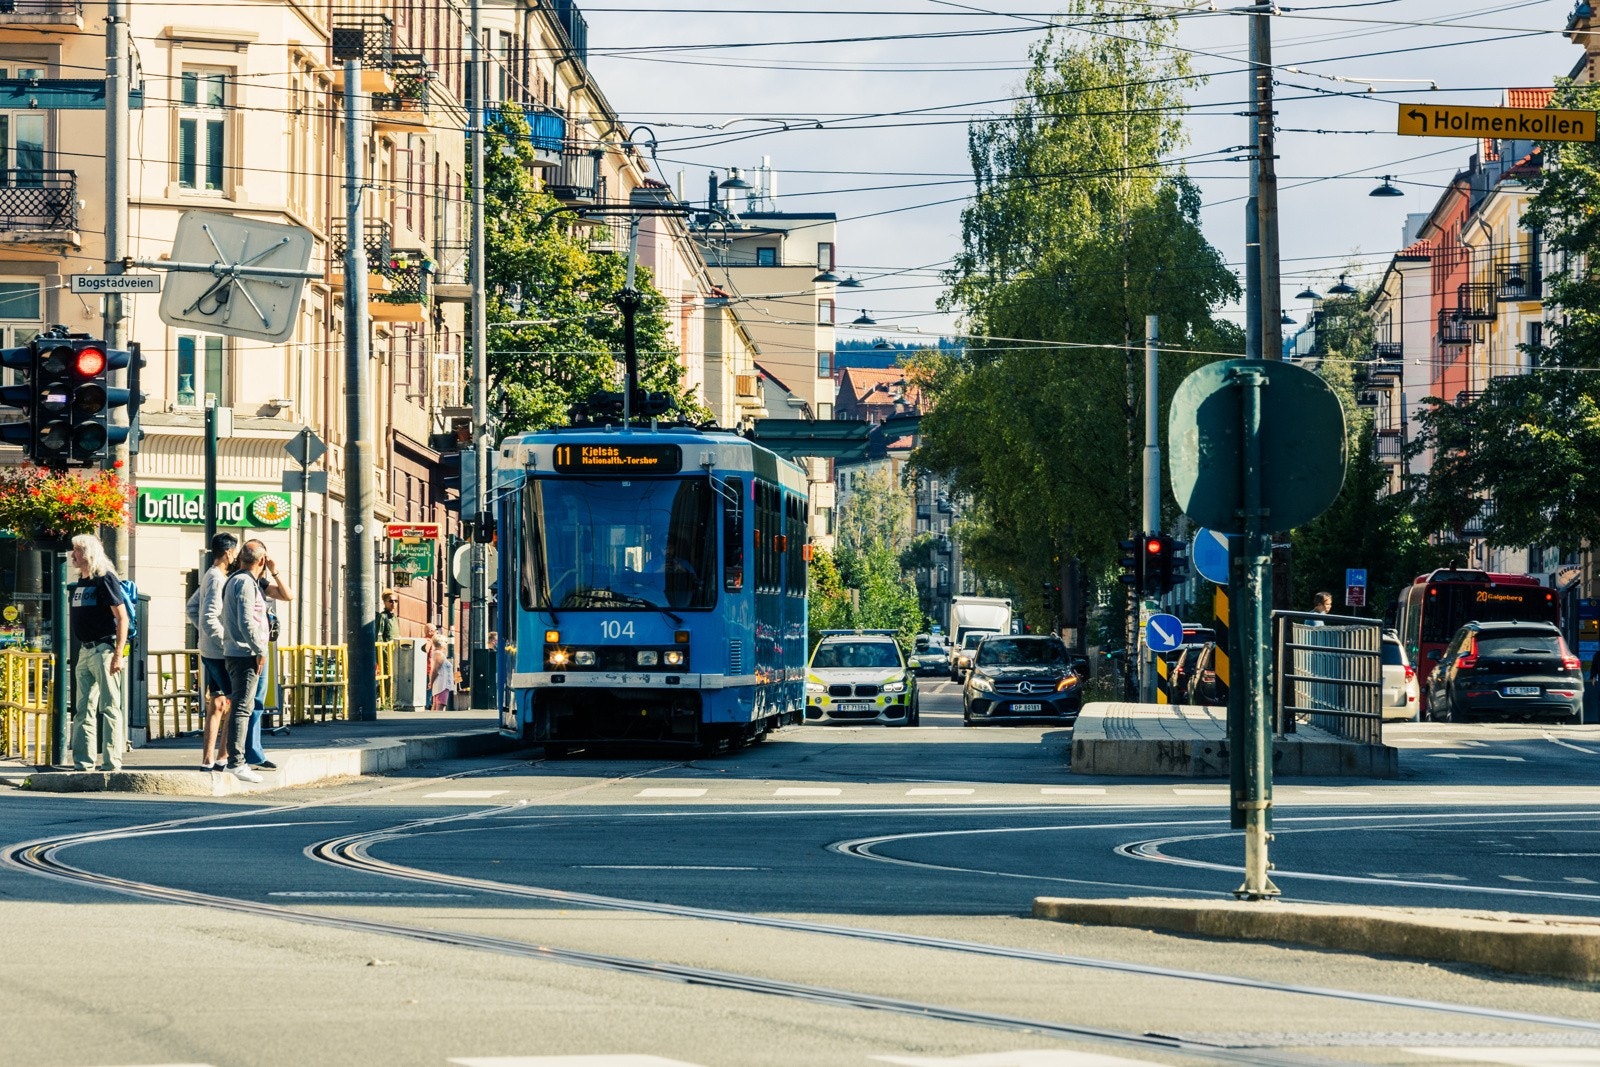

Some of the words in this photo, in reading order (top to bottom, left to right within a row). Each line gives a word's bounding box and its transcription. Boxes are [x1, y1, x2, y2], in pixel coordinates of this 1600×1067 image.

[1434, 110, 1584, 135] Holmenkollen
[78, 277, 153, 290] Bogstadveien
[557, 446, 571, 466] 11
[144, 492, 245, 521] brillelnd
[1476, 591, 1488, 602] 20
[600, 620, 636, 639] 104
